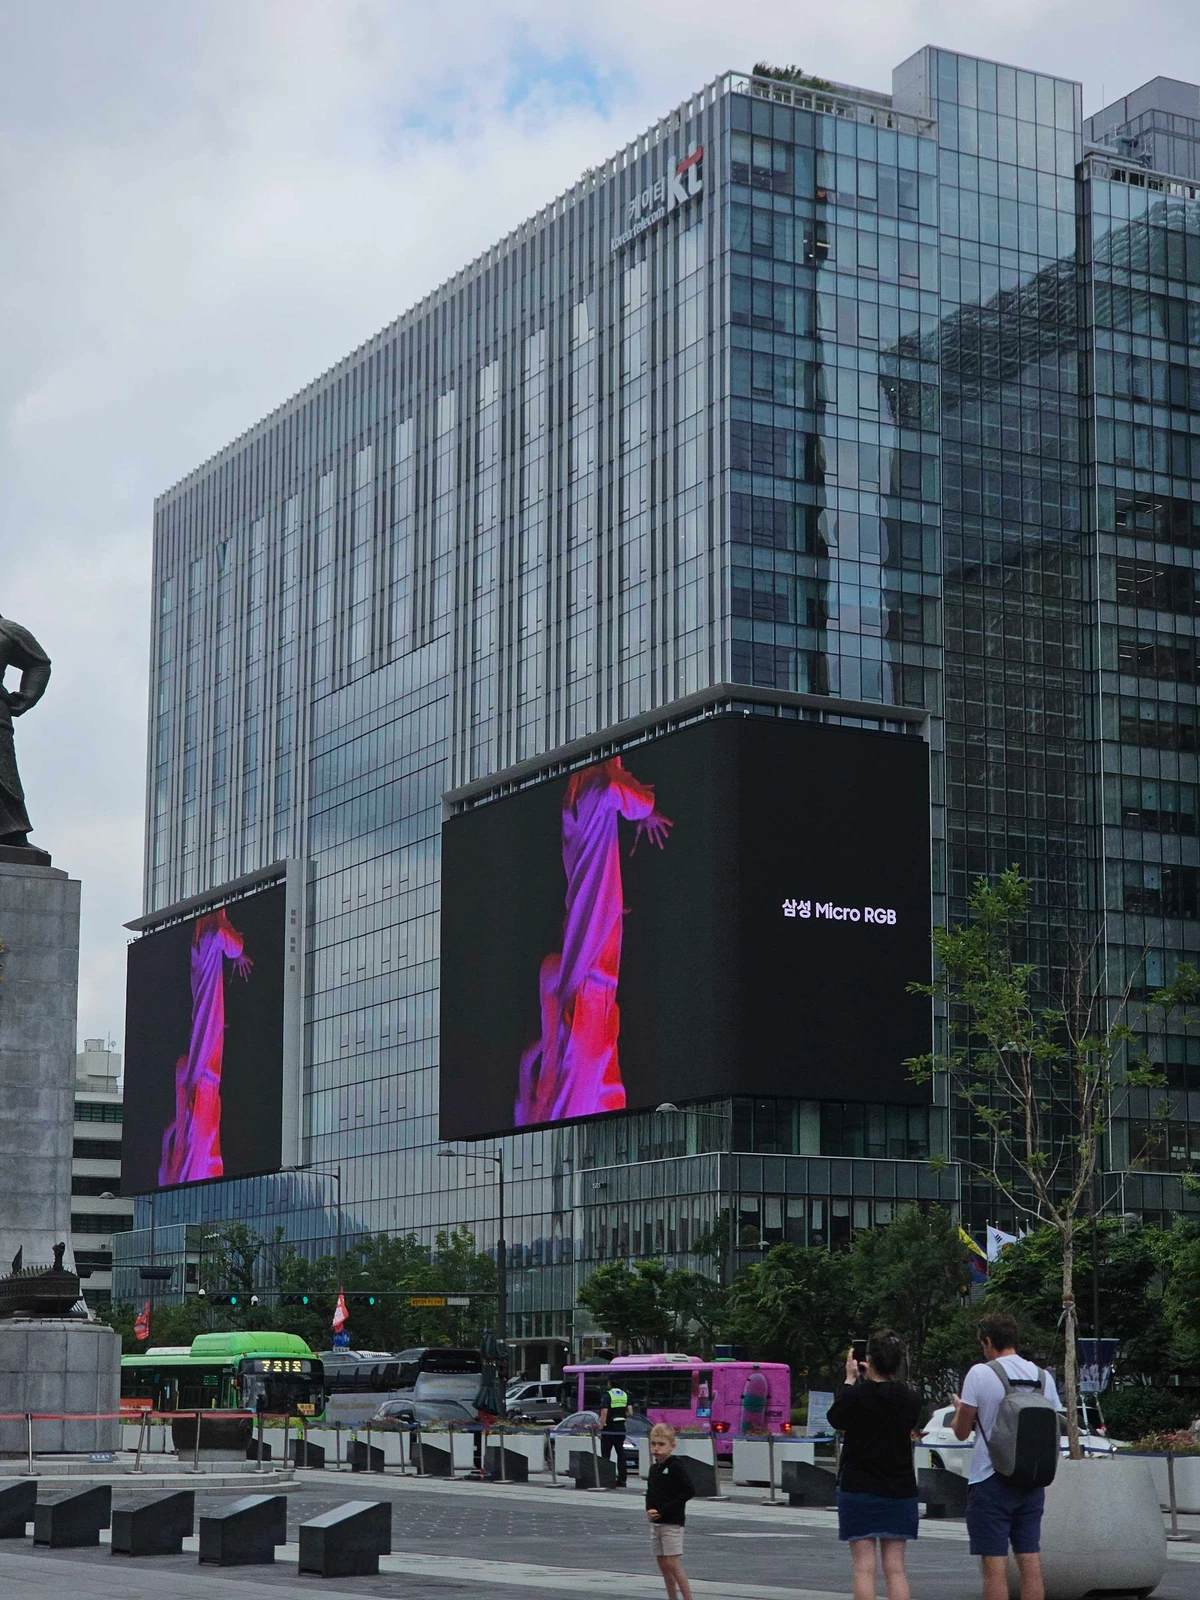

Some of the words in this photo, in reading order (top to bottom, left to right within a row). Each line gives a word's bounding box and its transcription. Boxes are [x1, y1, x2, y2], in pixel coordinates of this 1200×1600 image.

[667, 141, 704, 213] kt
[628, 176, 665, 219] 케이티
[782, 898, 811, 918] 삼성
[815, 902, 860, 922] Micro
[864, 906, 897, 925] RGB
[261, 1360, 302, 1372] 7212
